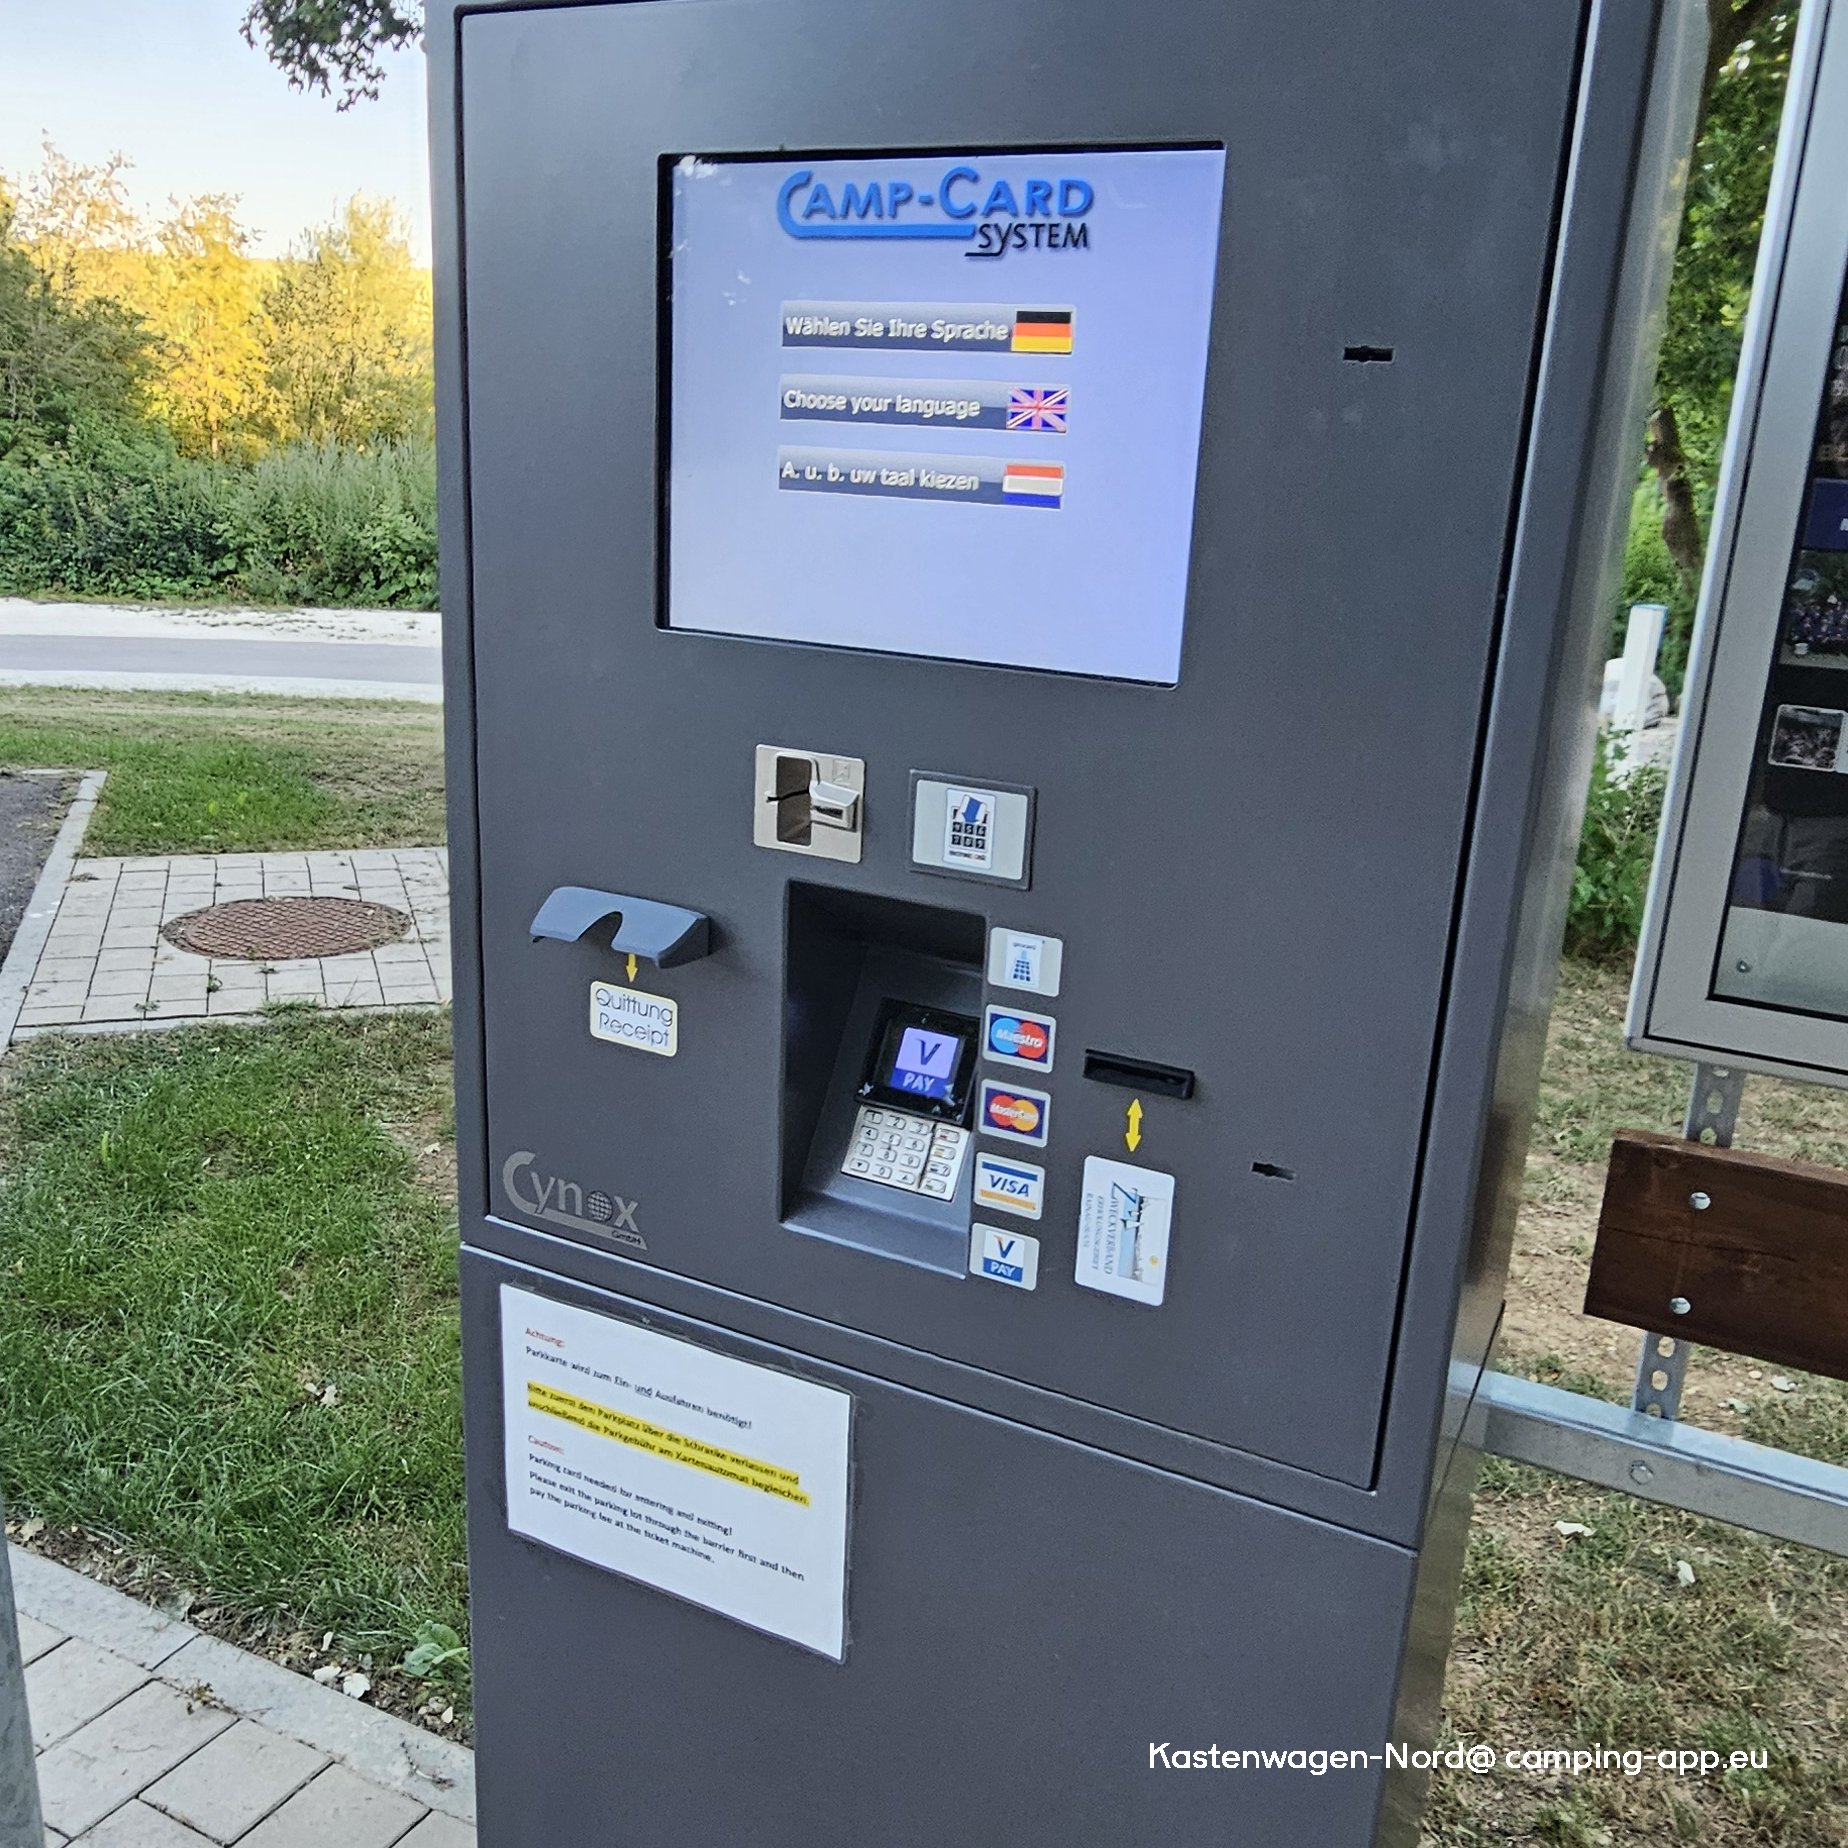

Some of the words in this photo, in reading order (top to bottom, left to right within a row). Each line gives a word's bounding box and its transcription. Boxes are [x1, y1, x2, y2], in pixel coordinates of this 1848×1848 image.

[786, 316, 850, 337] Wählen
[854, 317, 884, 337] Sie
[888, 318, 927, 338] Ihre
[931, 319, 1009, 343] Sprache
[783, 389, 847, 410] Choose
[851, 397, 892, 415] your
[895, 394, 981, 420] language
[782, 461, 800, 479] A.
[804, 464, 822, 480] u.
[827, 462, 845, 482] b.
[850, 468, 877, 485] uw
[880, 467, 915, 487] taal
[919, 468, 979, 491] kiezen
[595, 987, 674, 1027] Quittung
[599, 1012, 670, 1047] Receipt
[995, 1029, 1043, 1049] Maestro
[917, 1038, 942, 1066] V
[902, 1072, 936, 1092] PAY
[990, 1103, 1039, 1120] MasterC
[990, 1174, 1030, 1197] VISA
[994, 1235, 1015, 1259] V
[990, 1261, 1016, 1278] PAY
[526, 1345, 568, 1368] Parkkarte
[571, 1362, 591, 1376] wird
[593, 1371, 612, 1383] zum
[634, 1383, 653, 1397] und
[655, 1390, 704, 1413] Ausfahren
[707, 1407, 752, 1429] benötigt!
[658, 1446, 674, 1458] am
[779, 1472, 800, 1486] und
[529, 1453, 562, 1473] Parking
[563, 1466, 582, 1480] card
[584, 1475, 617, 1494] needed
[620, 1486, 632, 1499] for
[635, 1494, 674, 1516] entering
[677, 1509, 694, 1521] and
[697, 1516, 733, 1536] exiting!
[529, 1487, 545, 1500] pay
[547, 1492, 562, 1504] the
[564, 1500, 597, 1520] parking
[599, 1511, 613, 1524] fee
[614, 1519, 624, 1529] at
[626, 1523, 641, 1536] the
[644, 1529, 670, 1547] ticket
[671, 1540, 716, 1564] machine.
[529, 1470, 557, 1488] Please
[559, 1483, 575, 1496] exit
[577, 1489, 592, 1502] the
[594, 1496, 628, 1517] parking
[630, 1508, 643, 1521] lot
[645, 1515, 681, 1535] through
[684, 1529, 700, 1542] the
[702, 1534, 735, 1556] barrier
[738, 1548, 757, 1563] first
[759, 1558, 779, 1572] and
[781, 1565, 805, 1582] then
